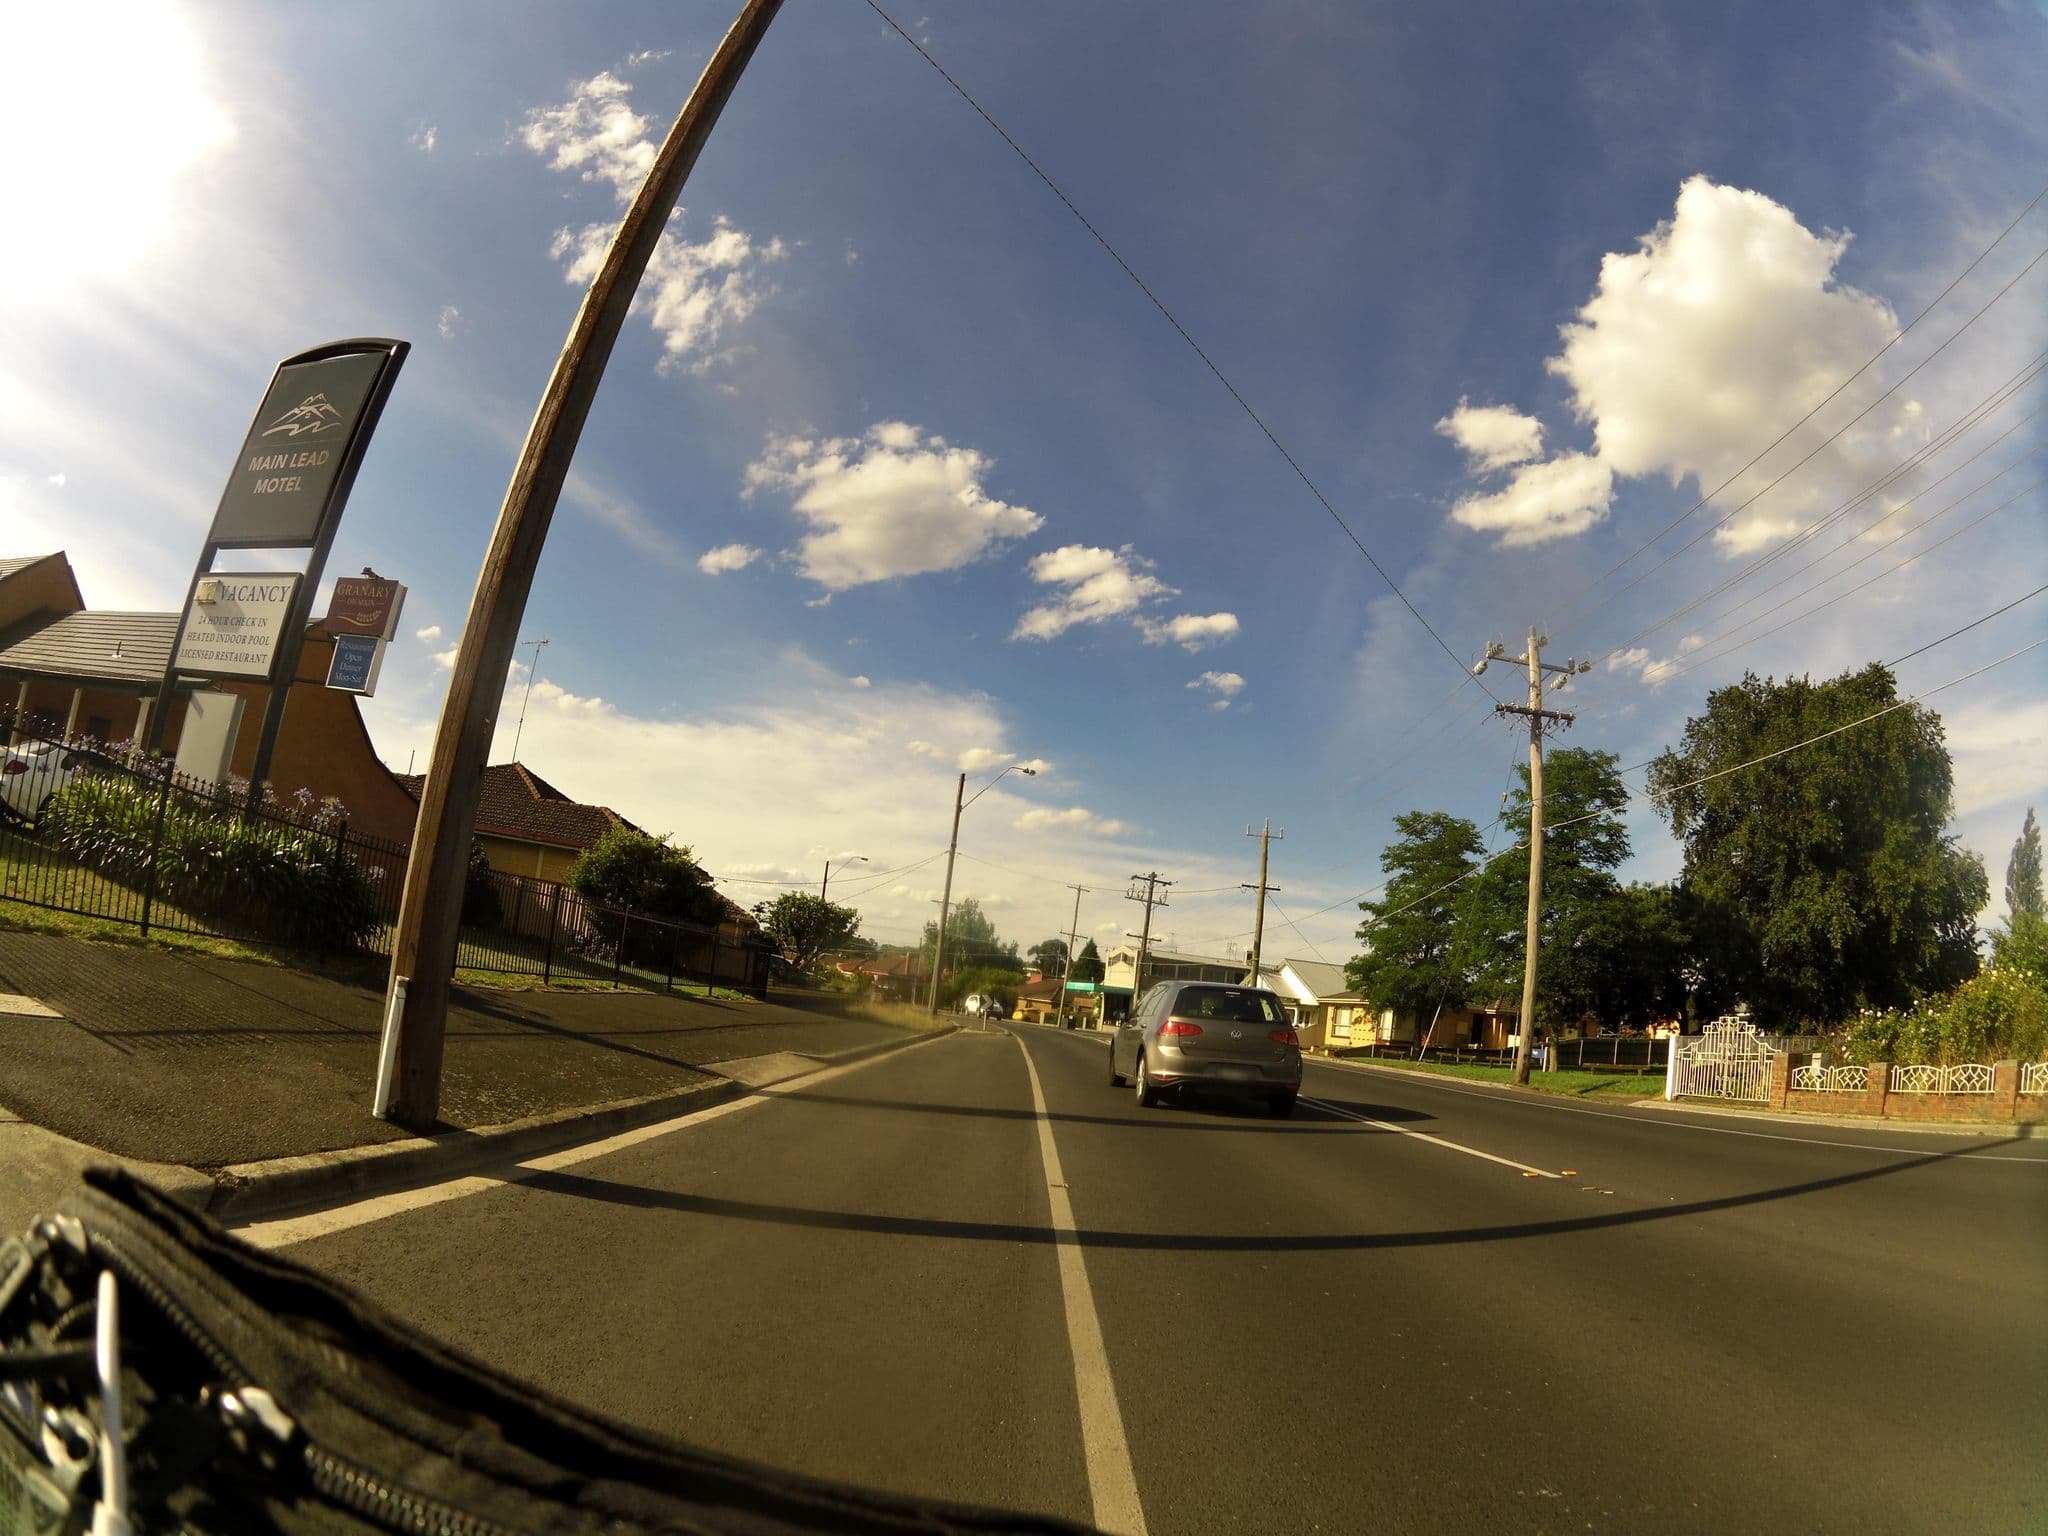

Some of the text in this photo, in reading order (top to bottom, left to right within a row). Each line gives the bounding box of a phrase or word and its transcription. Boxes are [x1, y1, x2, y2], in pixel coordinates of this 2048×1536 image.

[248, 450, 330, 471] MAIN LEAD
[253, 476, 301, 494] MOTEL
[220, 585, 290, 602] VACANCY
[337, 584, 390, 598] GRANARY
[207, 616, 228, 626] HOUR
[230, 616, 256, 627] CHECK
[259, 618, 268, 627] IN
[187, 632, 270, 646] HEATED INDOOR POOL
[180, 648, 268, 664] LICENSED RESTAURANT
[344, 652, 362, 663] Open
